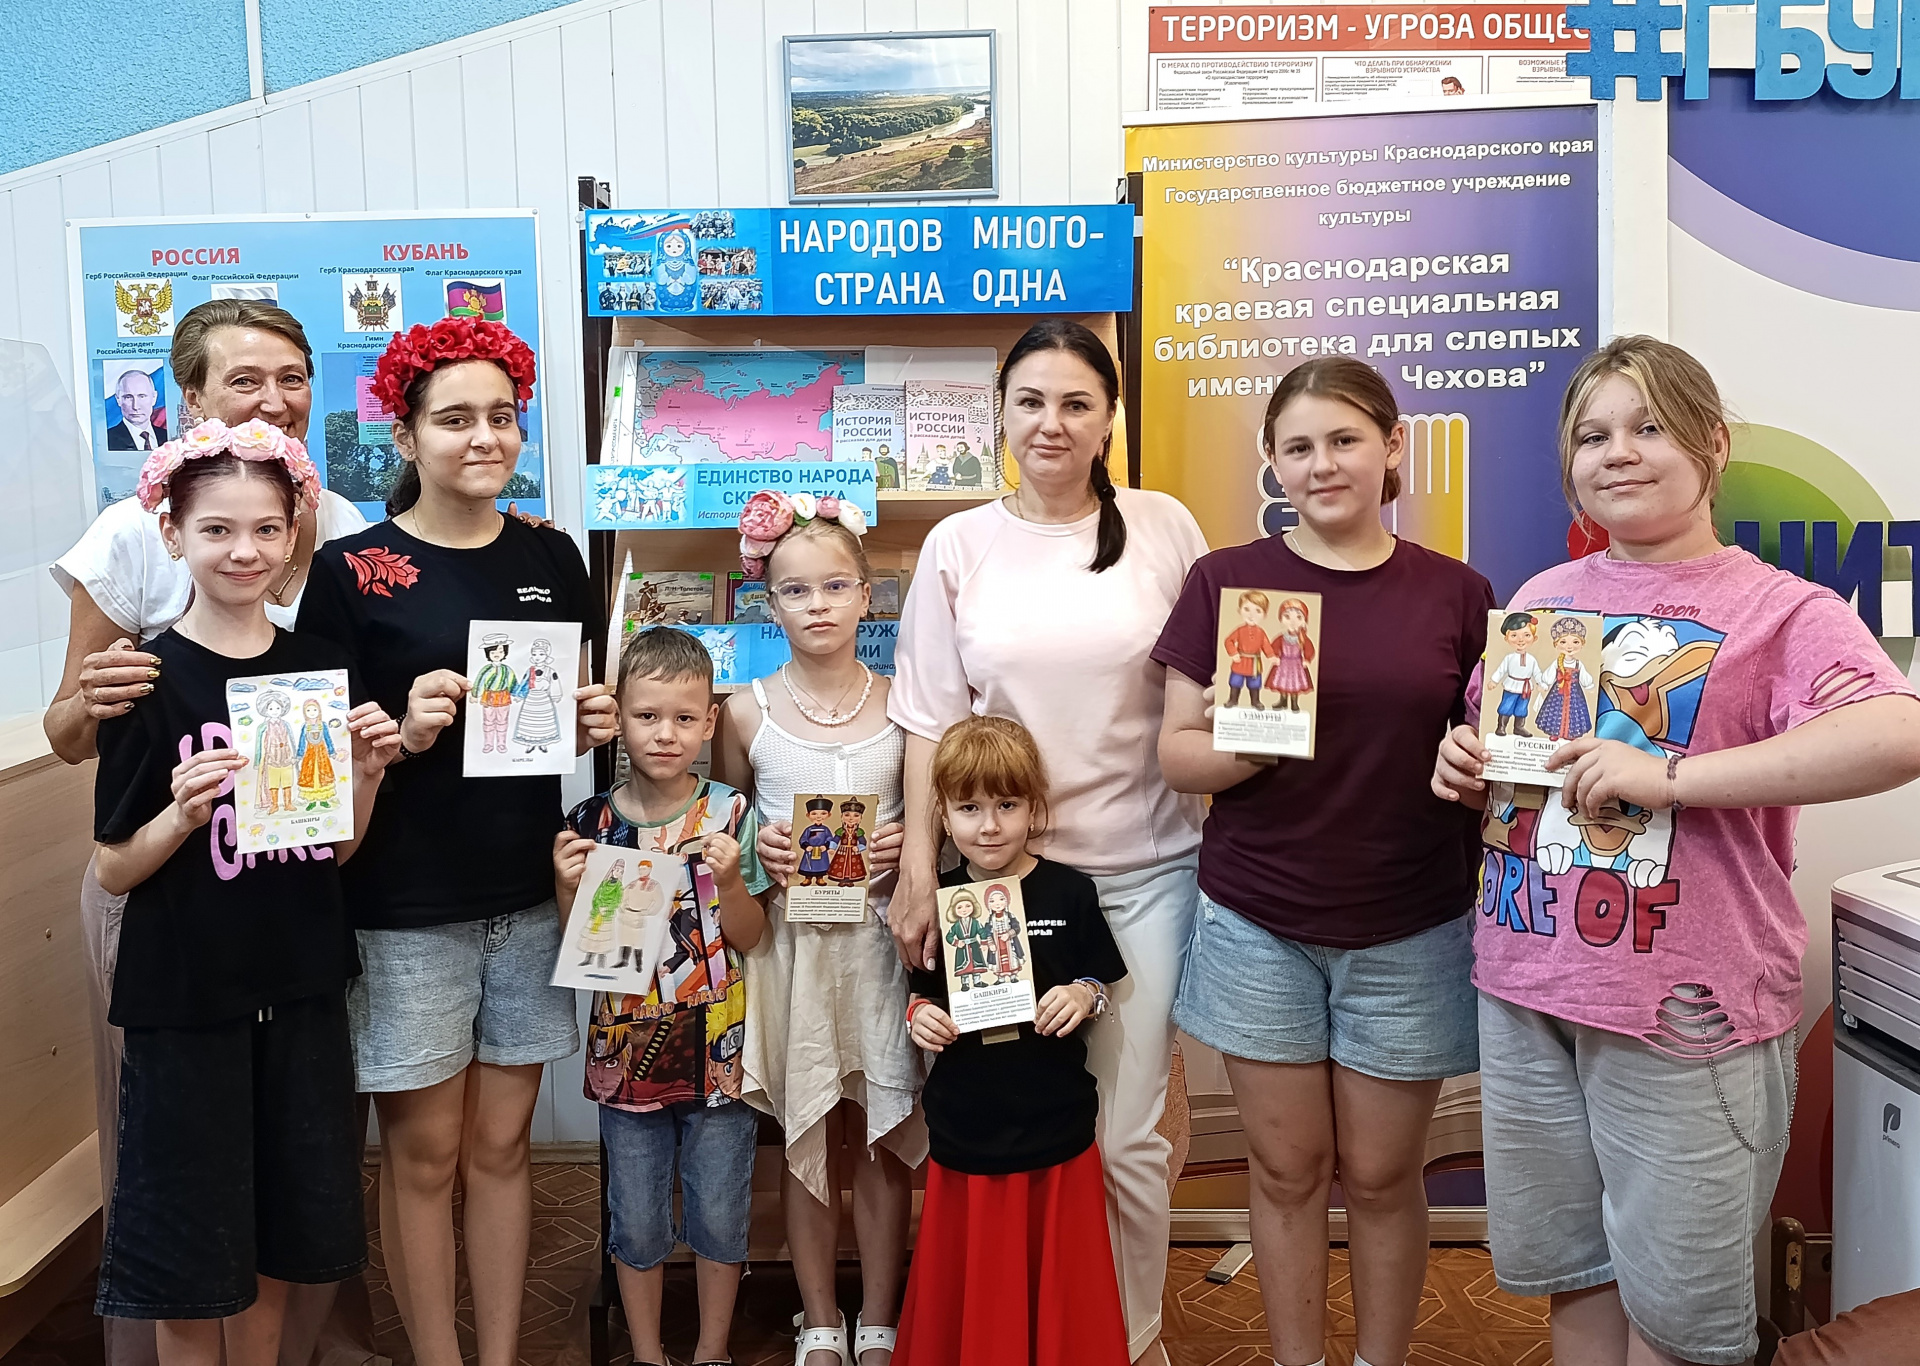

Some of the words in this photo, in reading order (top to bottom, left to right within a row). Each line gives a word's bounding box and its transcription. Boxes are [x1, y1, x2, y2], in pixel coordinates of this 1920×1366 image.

[1162, 15, 1338, 42] ТЕРРОРИЗМ
[1365, 13, 1475, 41] УГРОЗА
[1566, 0, 1920, 101] #ГБУ
[1201, 60, 1269, 68] ПРОТИВОДЕЙСТВИЮ
[1270, 60, 1314, 68] ТЕРРОРИЗМУ
[1142, 151, 1280, 173] Министерство
[1285, 147, 1378, 168] культуры
[1383, 140, 1543, 162] Краснодарского
[1548, 138, 1594, 156] края
[1164, 183, 1331, 205] Государственное
[1336, 177, 1447, 195] бюджетное
[1451, 172, 1571, 194] учреждение
[1318, 208, 1411, 228] культуры
[779, 218, 944, 259] НАРОДОВ
[972, 214, 1105, 250] МНОГО-
[151, 247, 240, 266] РОССИЯ
[383, 243, 469, 261] КУБАНЬ
[85, 271, 103, 280] Герб
[103, 270, 146, 279] Российской
[146, 270, 188, 278] Федерации
[210, 272, 255, 281] Российской
[256, 272, 300, 280] Федерации
[319, 266, 338, 274] Герб
[338, 266, 397, 274] Краснодарского
[398, 266, 415, 274] края
[444, 268, 503, 276] Краснодарского
[504, 268, 522, 276] края
[814, 271, 945, 306] СТРАНА
[972, 268, 1067, 308] ОДНА
[1175, 298, 1314, 328] краевая
[1325, 289, 1560, 320] специальная
[1153, 333, 1357, 362] библиотека
[1367, 331, 1434, 359] для
[1444, 327, 1581, 351] слепых
[1187, 376, 1284, 399] имен
[836, 416, 892, 426] ИСТОРИЯ
[910, 412, 965, 422] ИСТОРИЯ
[843, 427, 892, 438] РОССИИ
[916, 423, 965, 434] РОССИИ
[976, 436, 982, 444] 2
[697, 469, 793, 487] ЕДИНСТВО
[799, 468, 874, 486] НАРОДА
[1650, 603, 1702, 619] ROOM
[1518, 740, 1557, 751] РУССКИЕ
[290, 816, 320, 825] БАШКИРЫ
[1477, 850, 1559, 938] ORE
[1574, 867, 1681, 954] OF
[974, 988, 1008, 999] БАШКИРЫ
[632, 1002, 676, 1021] NARUTO
[687, 987, 727, 1009] NARUTO
